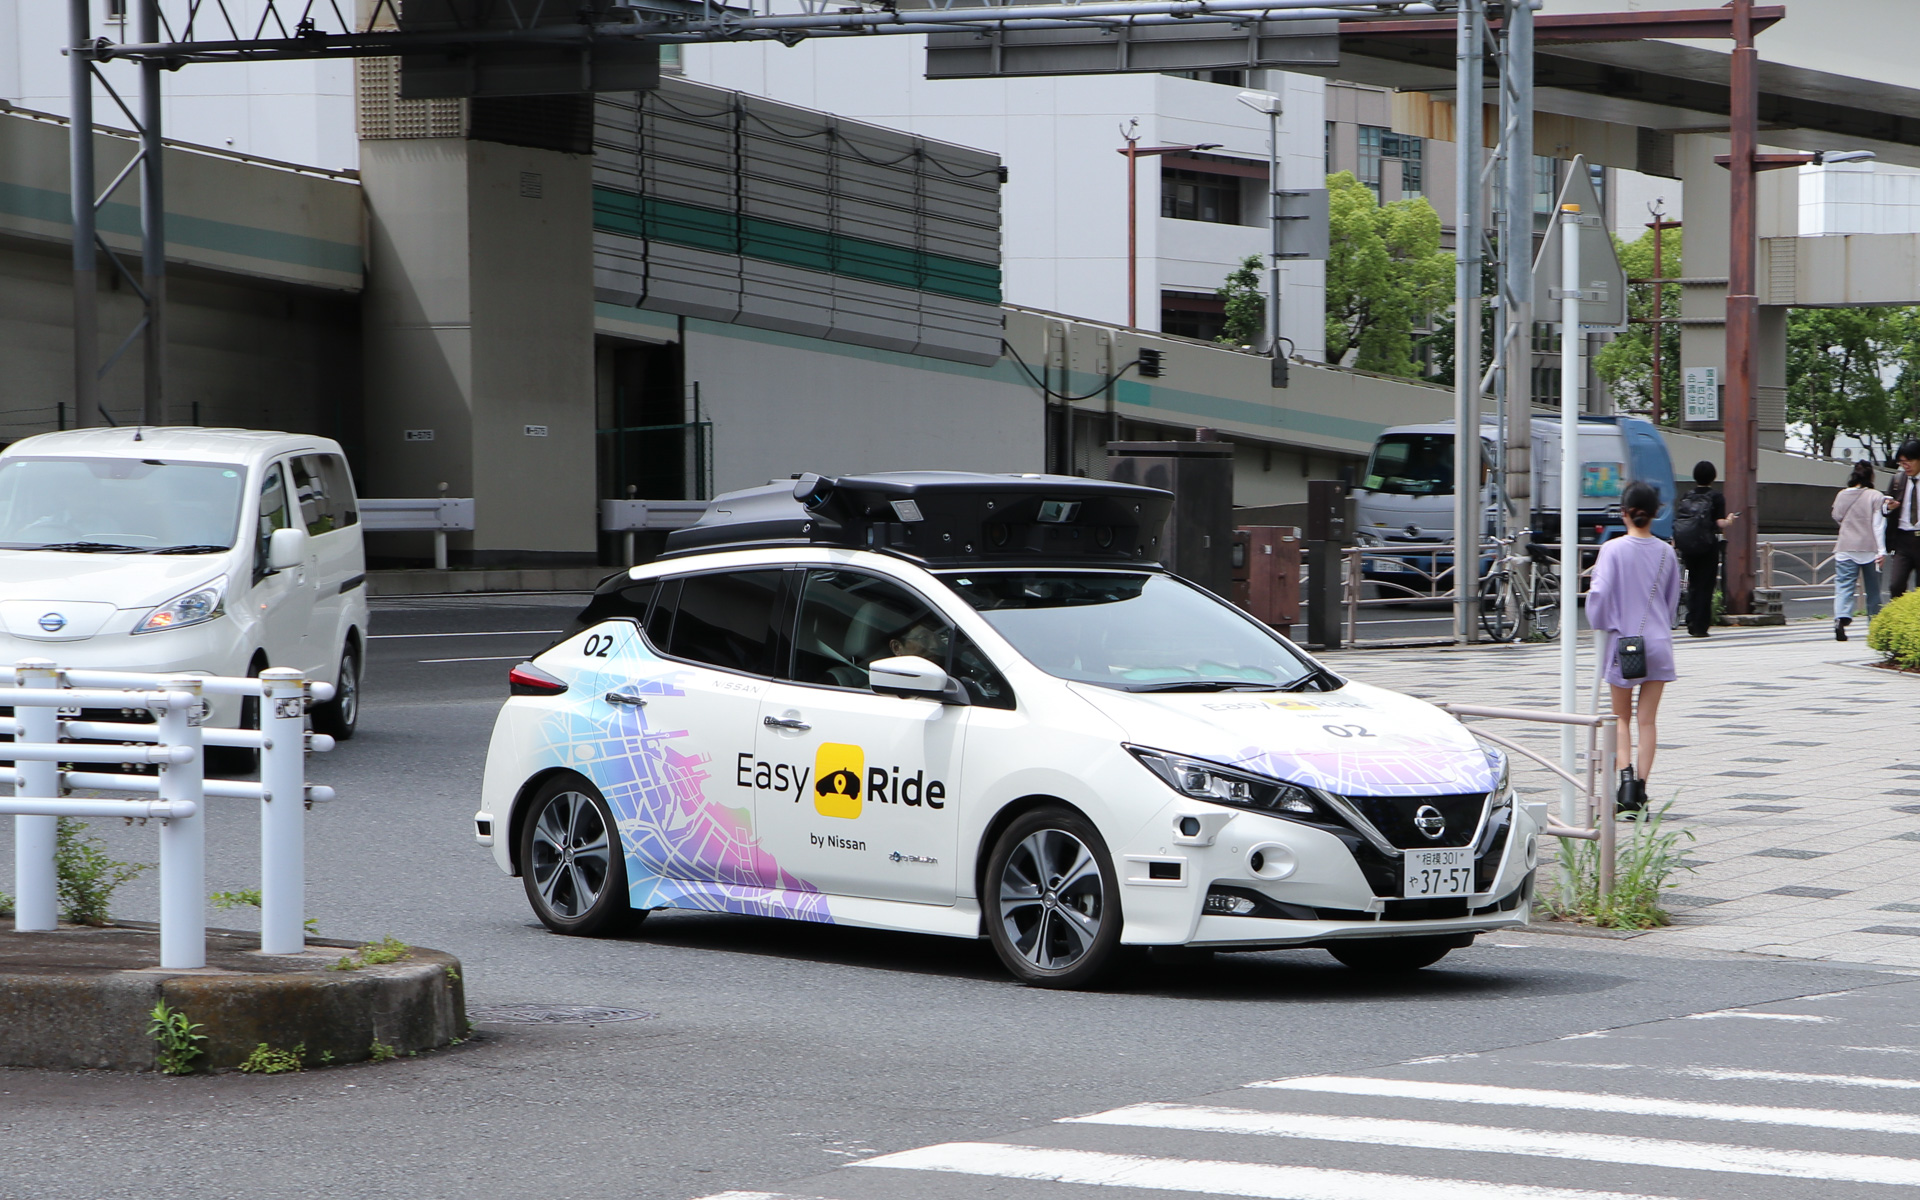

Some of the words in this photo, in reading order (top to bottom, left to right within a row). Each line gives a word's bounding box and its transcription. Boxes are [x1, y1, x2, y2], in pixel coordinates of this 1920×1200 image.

[583, 634, 614, 658] 02
[712, 681, 761, 693] NISSAN
[1202, 701, 1271, 711] Easy
[1322, 724, 1378, 738] 02
[737, 752, 810, 803] Easy
[867, 766, 946, 810] Ride
[810, 833, 825, 847] by
[828, 835, 866, 851] Nissan
[1421, 868, 1470, 894] 37-57
